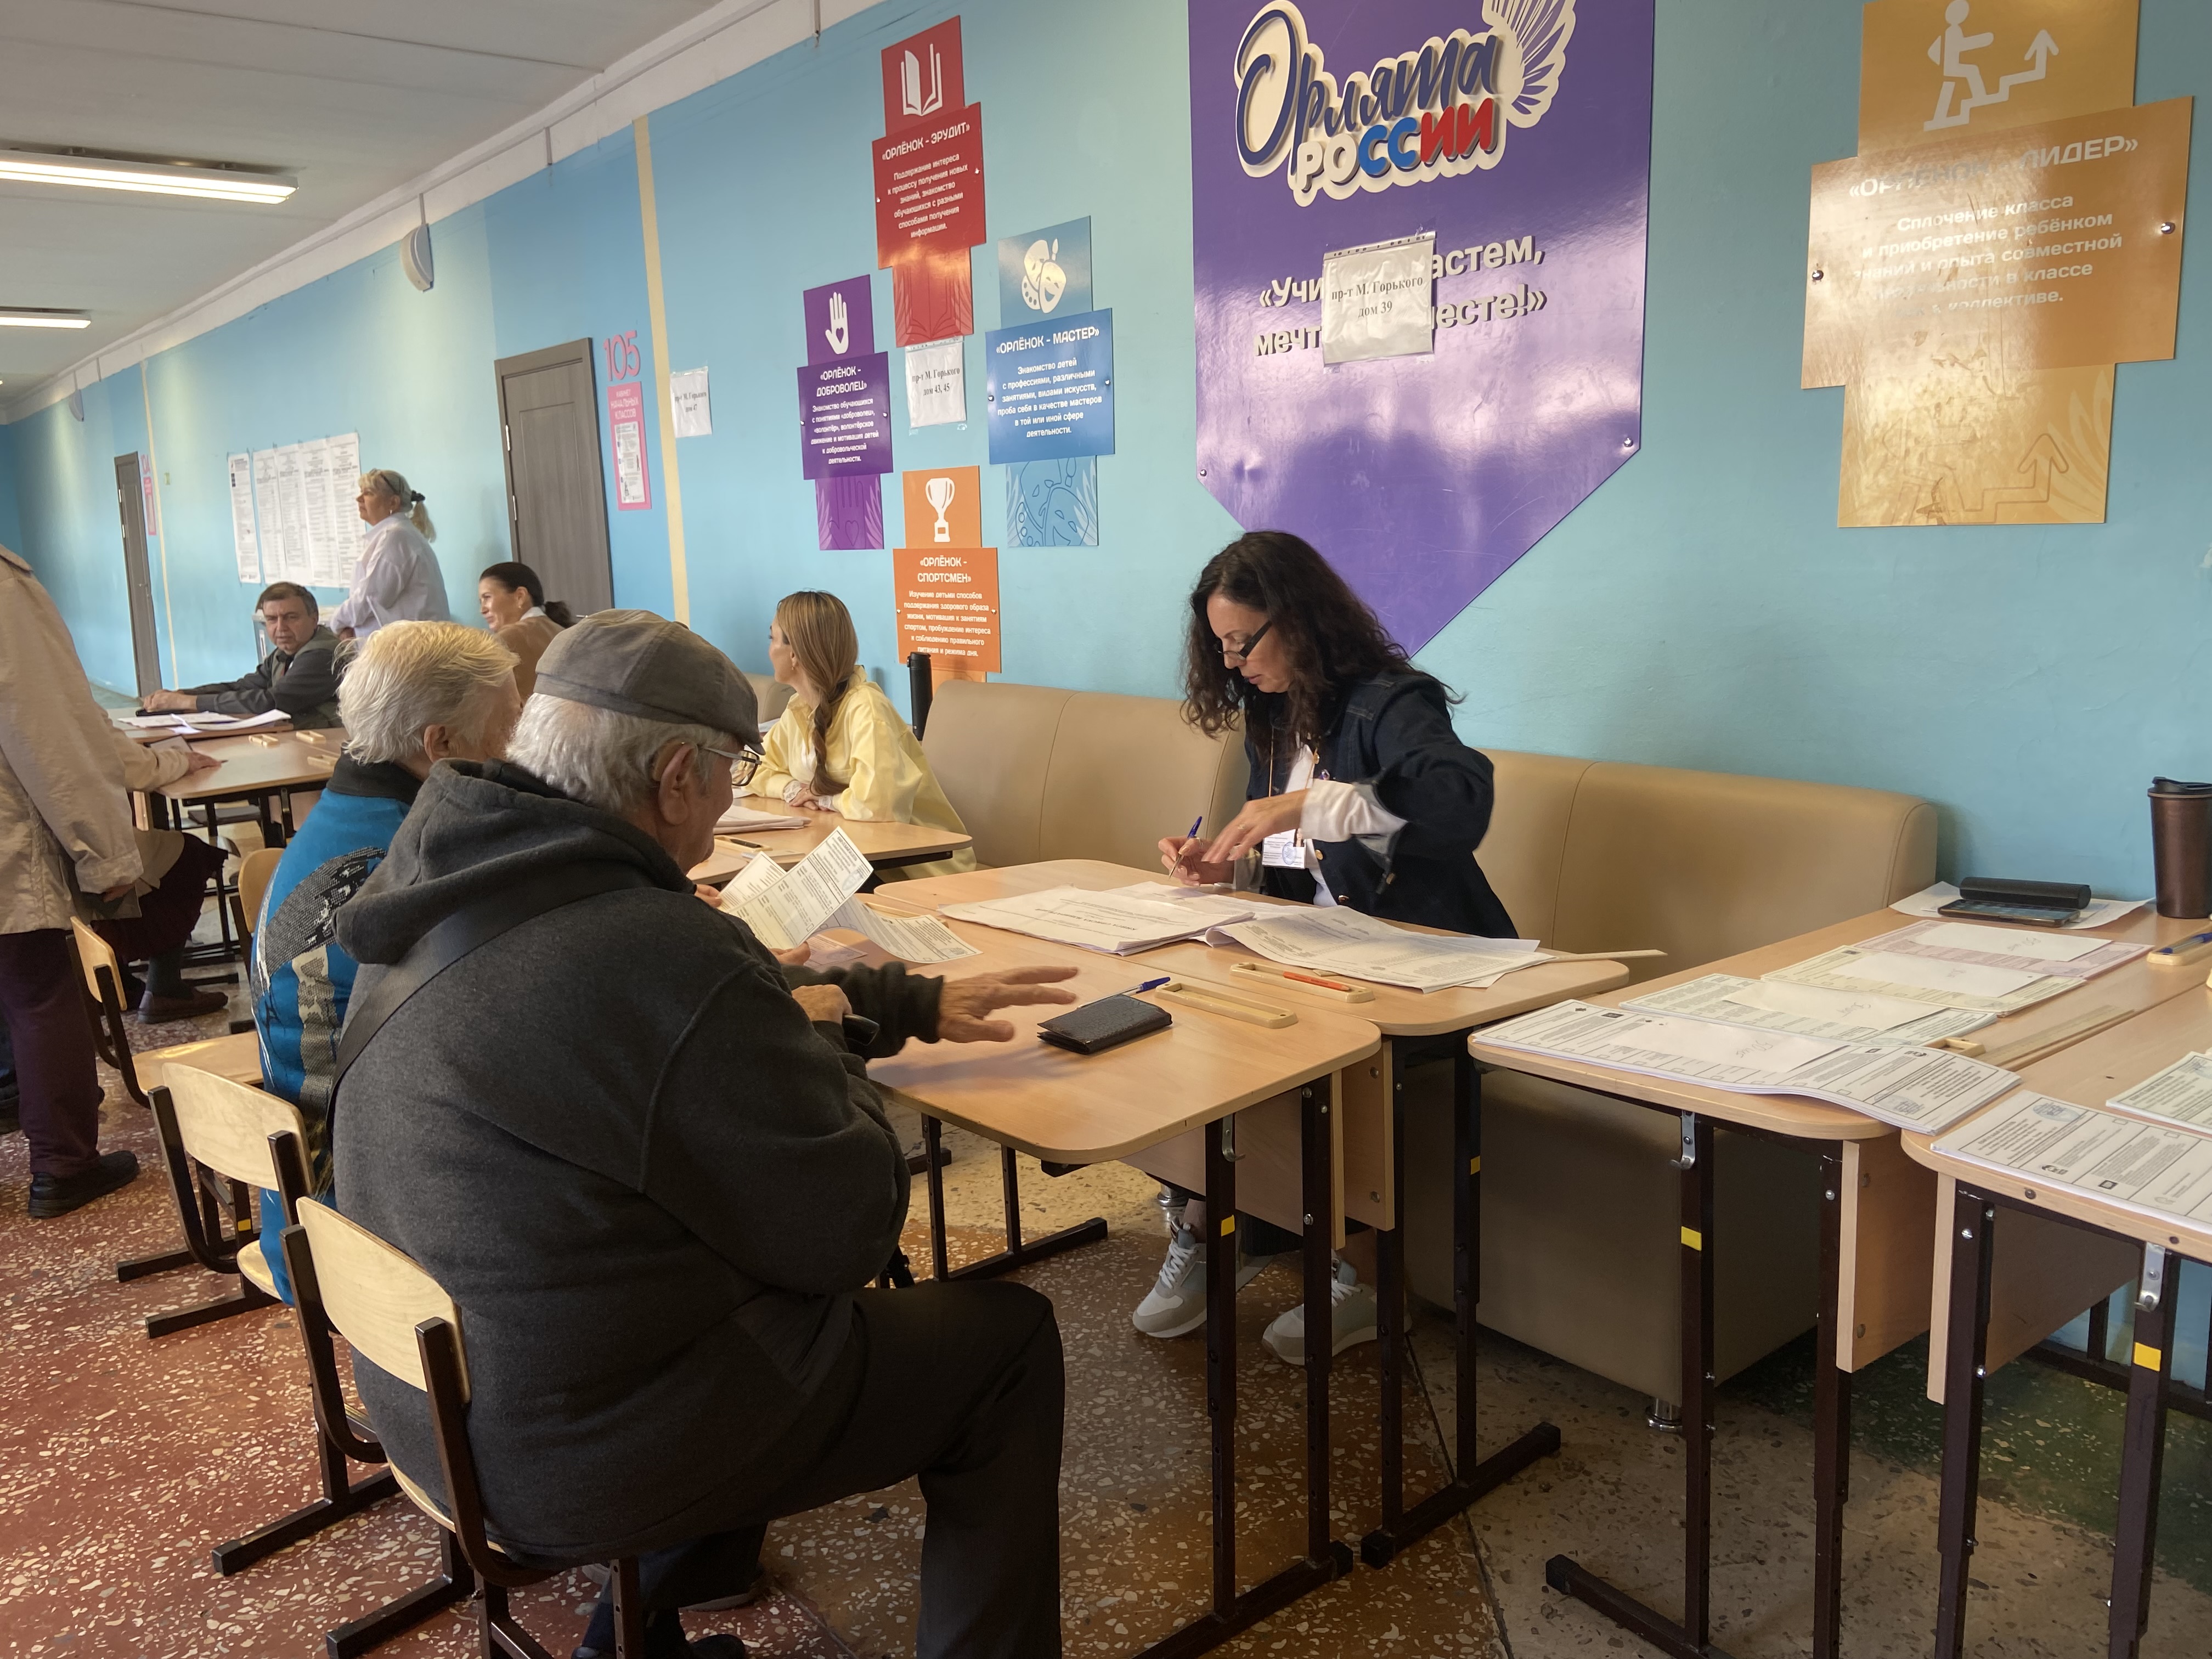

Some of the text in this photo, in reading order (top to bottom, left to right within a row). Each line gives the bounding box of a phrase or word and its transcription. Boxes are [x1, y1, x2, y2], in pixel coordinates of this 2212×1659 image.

[1236, 9, 1500, 176] Орлята
[882, 138, 924, 160] «ОРЛЁНОК
[931, 122, 970, 144] ЭРУДИТ»
[1296, 98, 1498, 193] РОССИИ
[933, 154, 960, 168] интереса
[2018, 136, 2139, 170] ЛИДЕР»
[918, 170, 949, 186] получения
[949, 164, 968, 176] новых
[922, 182, 956, 198] знакомство
[937, 192, 963, 207] разными
[898, 206, 960, 229] способами получения
[1897, 196, 2074, 231] Сплочение класса
[1862, 214, 2113, 258] и приобретение ребёнком
[1921, 260, 1932, 272] и
[1937, 252, 1995, 270] опыта
[2001, 233, 2123, 262] совместной
[1259, 235, 1545, 307] «Учи астем,
[2006, 272, 2018, 284] в
[2023, 263, 2094, 282] классе
[1331, 276, 1424, 302] пр-т М. Горького
[1357, 300, 1393, 319] дом 39
[1254, 283, 1548, 357] мечт есте!»
[996, 335, 1045, 354] «ОРЛЁНОК
[1053, 326, 1100, 345] МАСТЕР»
[603, 330, 641, 382] 105
[820, 366, 856, 381] «ОРЛЁНОК
[1018, 357, 1077, 375] Знакомство детей
[912, 374, 924, 384] пр-т
[933, 368, 960, 380] Горького
[1008, 377, 1052, 390] профессиями,
[1053, 370, 1096, 384] различными
[816, 380, 867, 397] ДОБРОВОЛЕЦ»
[923, 383, 950, 396] дом 43, 45
[1002, 383, 1097, 403] занятиями, видами искусств,
[812, 403, 840, 413] Знакомство
[997, 407, 1016, 417] проба
[1018, 404, 1032, 413] себя
[1039, 400, 1068, 411] качестве
[1070, 396, 1102, 407] мастеров
[1020, 417, 1031, 426] той
[1032, 416, 1045, 425] или
[1046, 413, 1062, 423] иной
[1063, 412, 1084, 422] сфере
[864, 430, 879, 439] детей
[1026, 427, 1072, 438] деятельности.
[919, 555, 962, 567] «ОРЛЁНОК
[917, 573, 972, 583] СПОРТСМЕН»
[909, 590, 935, 599] Изучение
[956, 591, 983, 600] способов
[940, 603, 968, 612] здорового
[969, 603, 989, 612] образа
[904, 624, 928, 632] спортом,
[965, 628, 991, 636] интереса
[950, 638, 984, 646] правильного
[945, 648, 966, 657] режима
